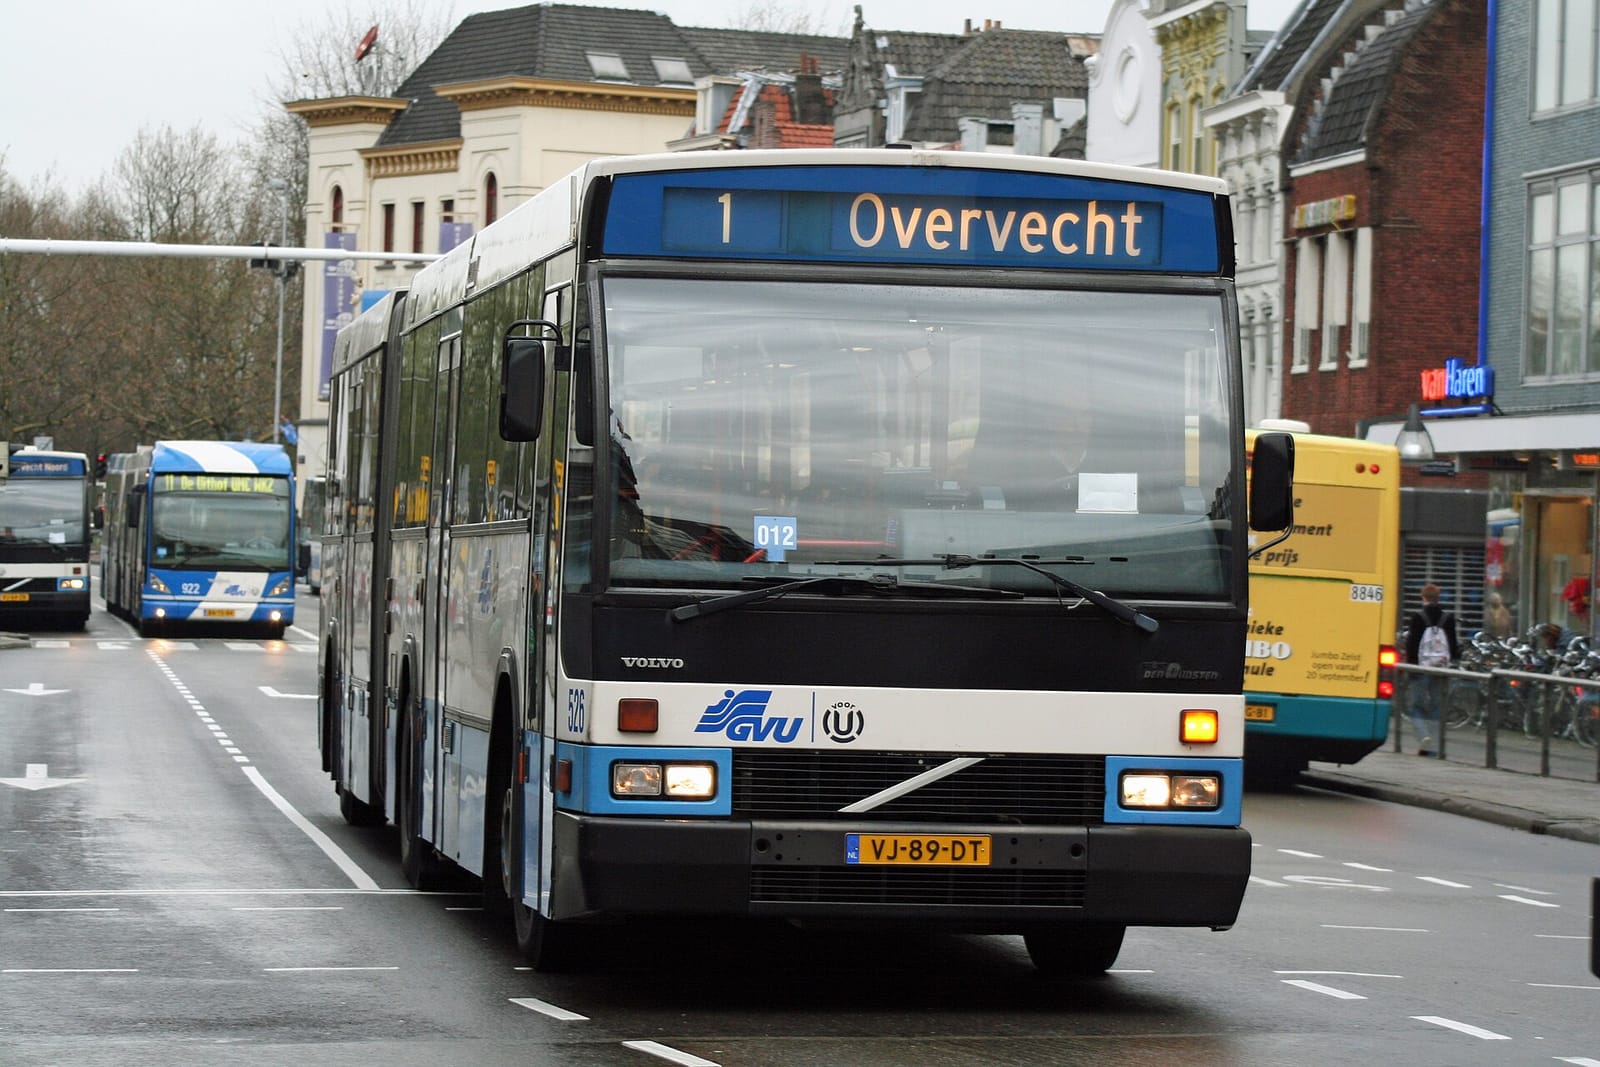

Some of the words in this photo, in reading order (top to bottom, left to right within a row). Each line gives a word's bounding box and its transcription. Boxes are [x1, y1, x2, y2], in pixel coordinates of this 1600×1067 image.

[717, 192, 732, 244] 1
[848, 192, 1143, 257] Overvecht
[757, 525, 794, 546] 012
[1291, 524, 1333, 537] ment
[1264, 549, 1299, 566] prijs
[181, 583, 200, 595] 922
[1351, 586, 1383, 601] 8846
[621, 657, 684, 669] VOLVO
[567, 688, 585, 734] 526
[725, 717, 805, 743] GVU
[847, 852, 858, 860] NL
[871, 839, 983, 861] VJ-89-DT
